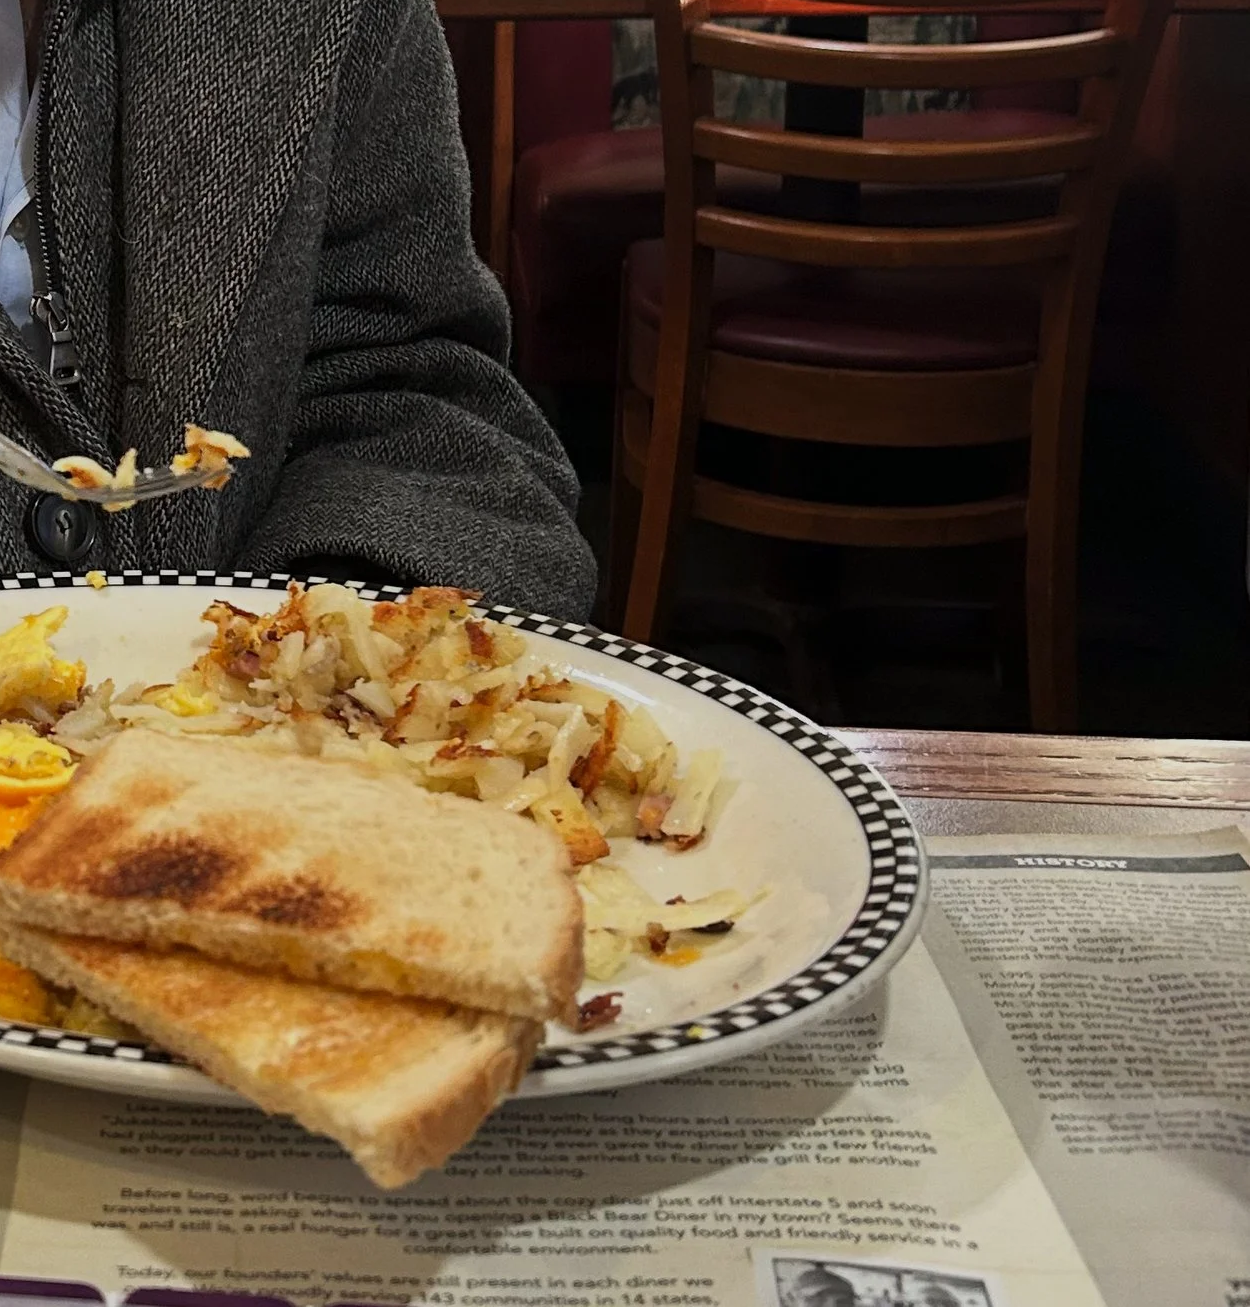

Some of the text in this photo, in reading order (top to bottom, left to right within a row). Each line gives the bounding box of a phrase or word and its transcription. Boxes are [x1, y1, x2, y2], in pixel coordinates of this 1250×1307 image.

[1013, 857, 1128, 869] HISTORY
[867, 1041, 884, 1050] or
[769, 1066, 835, 1076] biscuits
[873, 1063, 905, 1075] big
[719, 1079, 797, 1089] oranges.
[859, 1078, 910, 1087] items
[551, 1113, 589, 1123] with
[594, 1113, 634, 1125] long
[639, 1114, 689, 1125] hours
[696, 1115, 729, 1125] and
[735, 1115, 817, 1126] counting
[822, 1115, 898, 1126] pennies.
[100, 1129, 133, 1139] had
[139, 1131, 215, 1143] plugged
[527, 1125, 593, 1137] payday
[598, 1127, 617, 1136] as
[624, 1126, 663, 1138] they
[669, 1127, 746, 1139] emptied
[752, 1128, 784, 1138] the
[788, 1128, 865, 1140] quarters
[871, 1128, 932, 1140] guests
[119, 1145, 140, 1154] so
[145, 1145, 184, 1157] they
[189, 1146, 241, 1157] could
[245, 1148, 277, 1160] get
[282, 1149, 311, 1158] the
[506, 1139, 547, 1150] They
[554, 1140, 600, 1149] even
[605, 1141, 649, 1152] gave
[655, 1140, 686, 1150] the
[691, 1141, 738, 1150] diner
[743, 1141, 786, 1152] keys
[792, 1142, 812, 1151] to
[833, 1141, 868, 1150] few
[872, 1141, 938, 1154] friends
[516, 1152, 569, 1162] Bruce
[576, 1153, 640, 1163] arrived
[646, 1154, 666, 1163] to
[671, 1153, 701, 1163] fire
[708, 1157, 732, 1167] up
[736, 1155, 768, 1165] the
[774, 1155, 810, 1166] grill
[815, 1154, 841, 1164] for
[848, 1155, 921, 1168] another
[446, 1167, 478, 1177] day
[484, 1166, 503, 1176] of
[120, 1187, 937, 1214] Before long, word began to spread about the cozy diner just off Interstate 5 and soon
[102, 1204, 182, 1215] travelers
[188, 1207, 233, 1217] were
[312, 1209, 362, 1220] when
[368, 1212, 398, 1221] are
[403, 1213, 439, 1223] you
[445, 1212, 524, 1224] opening
[530, 1213, 542, 1222] a
[546, 1211, 597, 1222] Black
[604, 1211, 648, 1222] Bear
[654, 1211, 708, 1222] Diner
[714, 1211, 732, 1222] in
[738, 1213, 767, 1225] my
[772, 1212, 831, 1224] town?
[837, 1213, 904, 1227] Seems
[909, 1218, 961, 1232] there
[138, 1219, 174, 1230] and
[180, 1220, 211, 1231] still
[243, 1224, 254, 1232] a
[260, 1222, 294, 1232] real
[301, 1223, 369, 1237] hunger
[374, 1226, 401, 1236] for
[408, 1229, 419, 1237] a
[424, 1228, 475, 1240] great
[481, 1227, 533, 1238] value
[539, 1228, 583, 1238] built
[588, 1229, 613, 1238] on
[620, 1228, 685, 1241] quality
[691, 1227, 738, 1239] food
[745, 1227, 781, 1239] and
[787, 1228, 862, 1243] friendly
[868, 1232, 935, 1245] service
[942, 1237, 961, 1249] in
[967, 1241, 978, 1250] a
[403, 1243, 659, 1255] comfortable environment.
[184, 1268, 217, 1278] our
[322, 1271, 383, 1284] values
[390, 1276, 420, 1286] are
[426, 1275, 460, 1287] still
[466, 1276, 541, 1289] present
[548, 1277, 566, 1288] in
[573, 1277, 621, 1288] each
[625, 1277, 678, 1288] diner
[684, 1278, 714, 1286] we
[340, 1291, 411, 1303] serving
[420, 1292, 455, 1305] 143
[461, 1294, 590, 1307] communities
[596, 1294, 614, 1305] in
[622, 1293, 647, 1305] 14
[652, 1294, 719, 1307] states,
